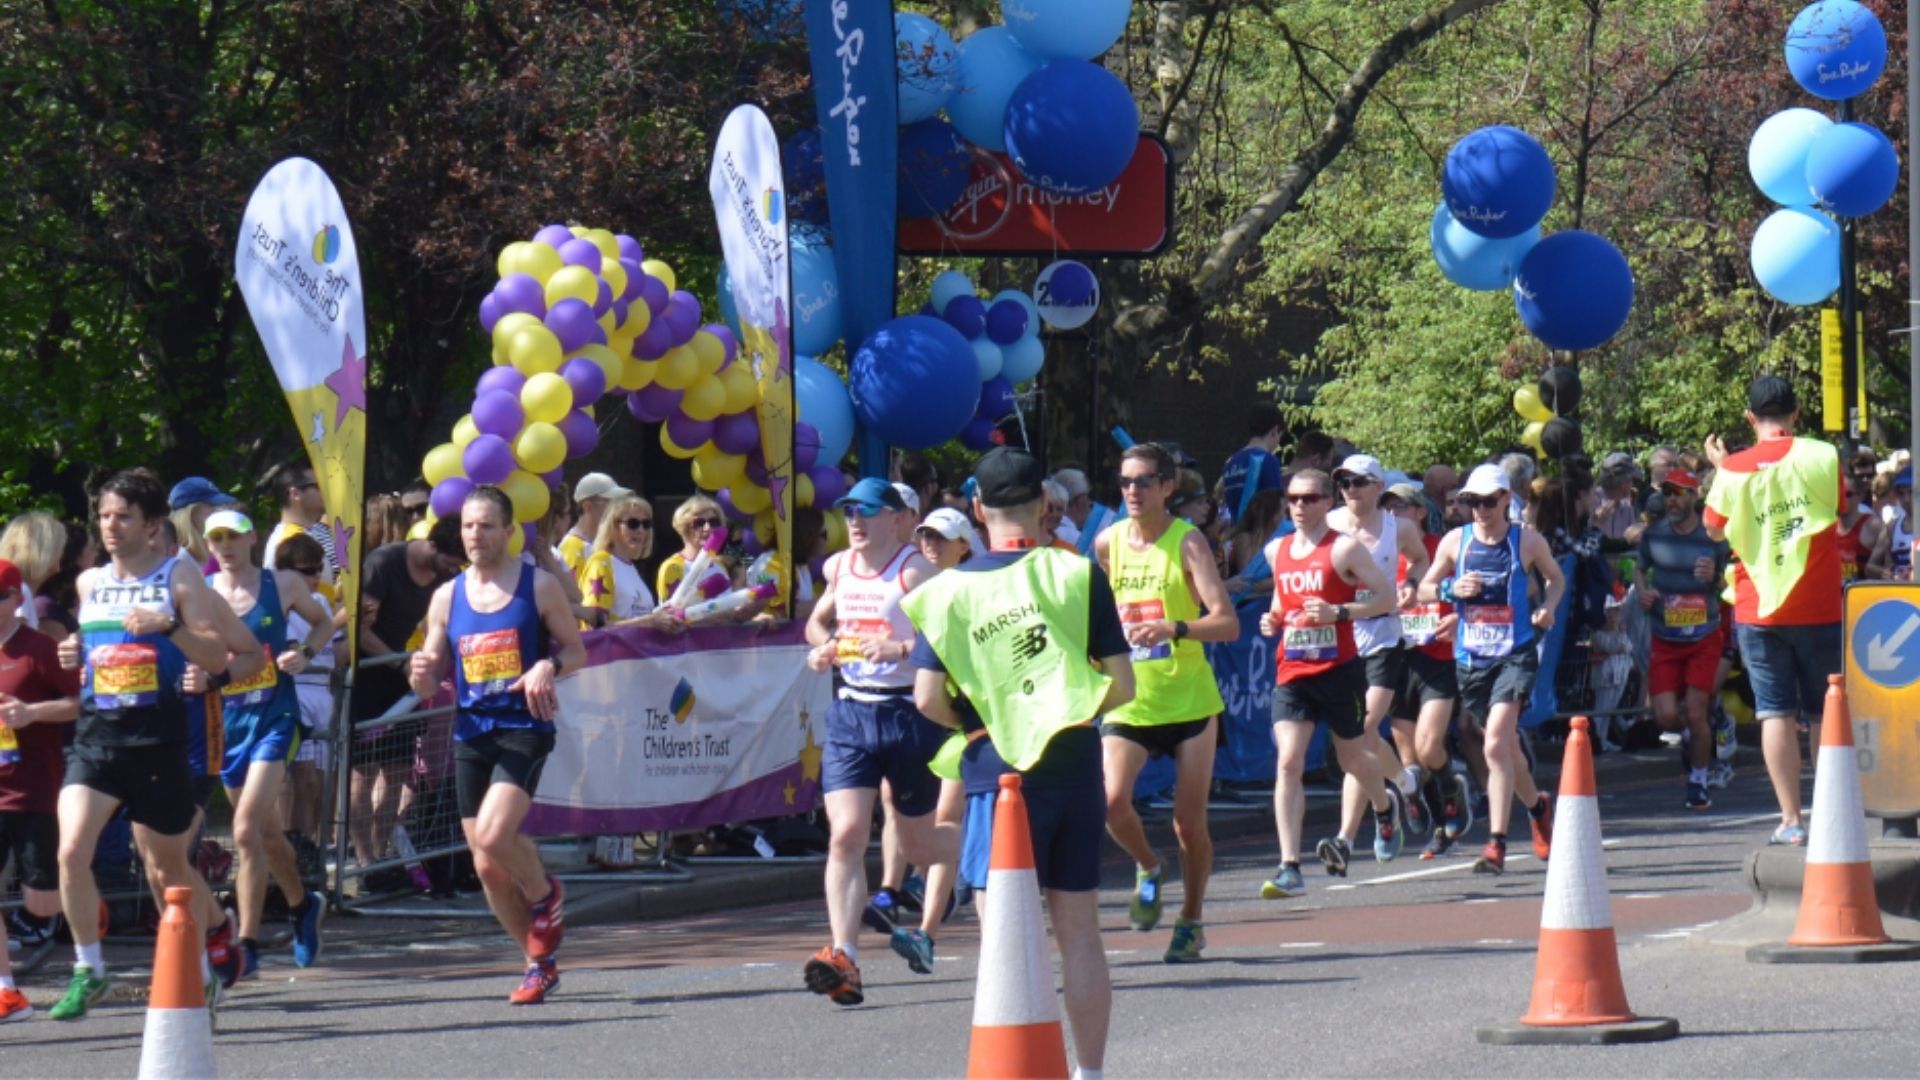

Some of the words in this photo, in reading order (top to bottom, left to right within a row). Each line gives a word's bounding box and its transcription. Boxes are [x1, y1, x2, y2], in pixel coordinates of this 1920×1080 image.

[1840, 61, 1871, 80] Ryder
[1469, 204, 1508, 227] Ryder
[1754, 493, 1812, 528] MRSHAL
[90, 584, 164, 604] KETTLE
[1279, 569, 1323, 595] TOM
[971, 602, 1041, 646] MARSH
[645, 707, 669, 731] The
[643, 736, 700, 760] Children's
[704, 735, 731, 758] Trust
